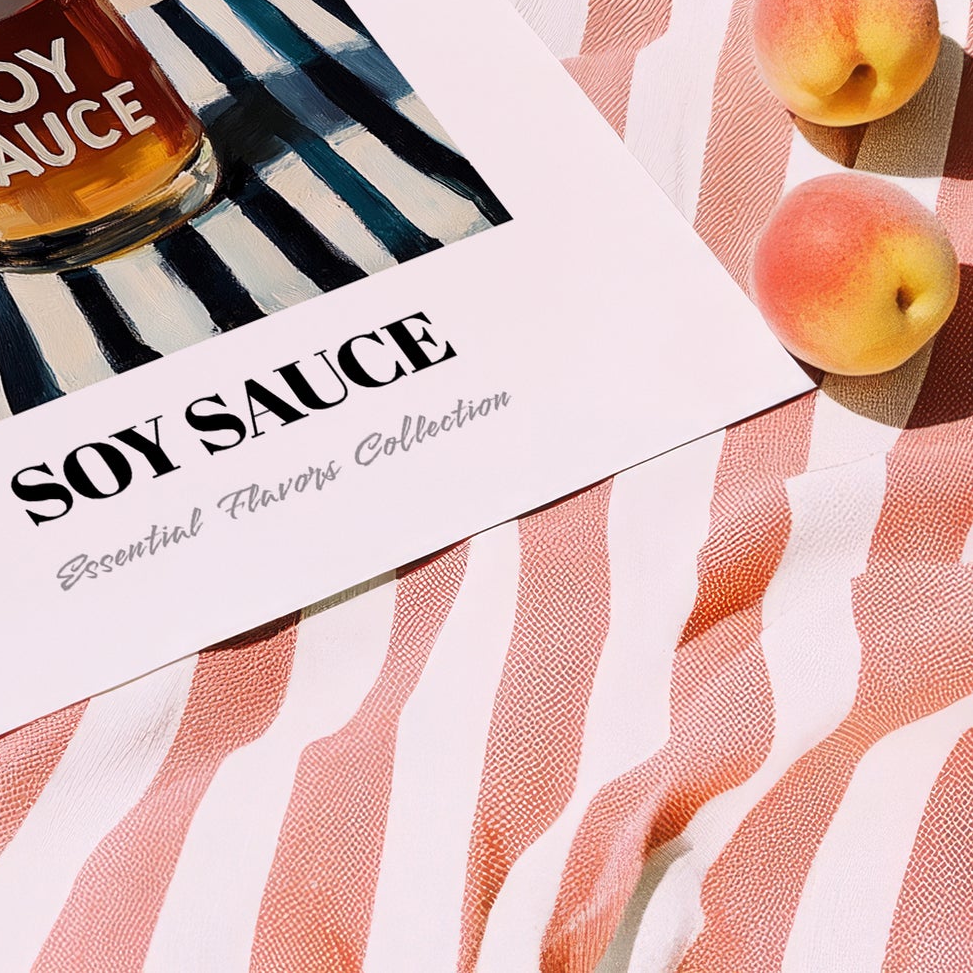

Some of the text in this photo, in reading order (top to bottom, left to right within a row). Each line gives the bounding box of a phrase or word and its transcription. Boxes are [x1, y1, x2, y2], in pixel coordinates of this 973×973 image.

[10, 311, 458, 527] SOY SAUCE
[55, 389, 512, 591] Essential Flavors Collection
